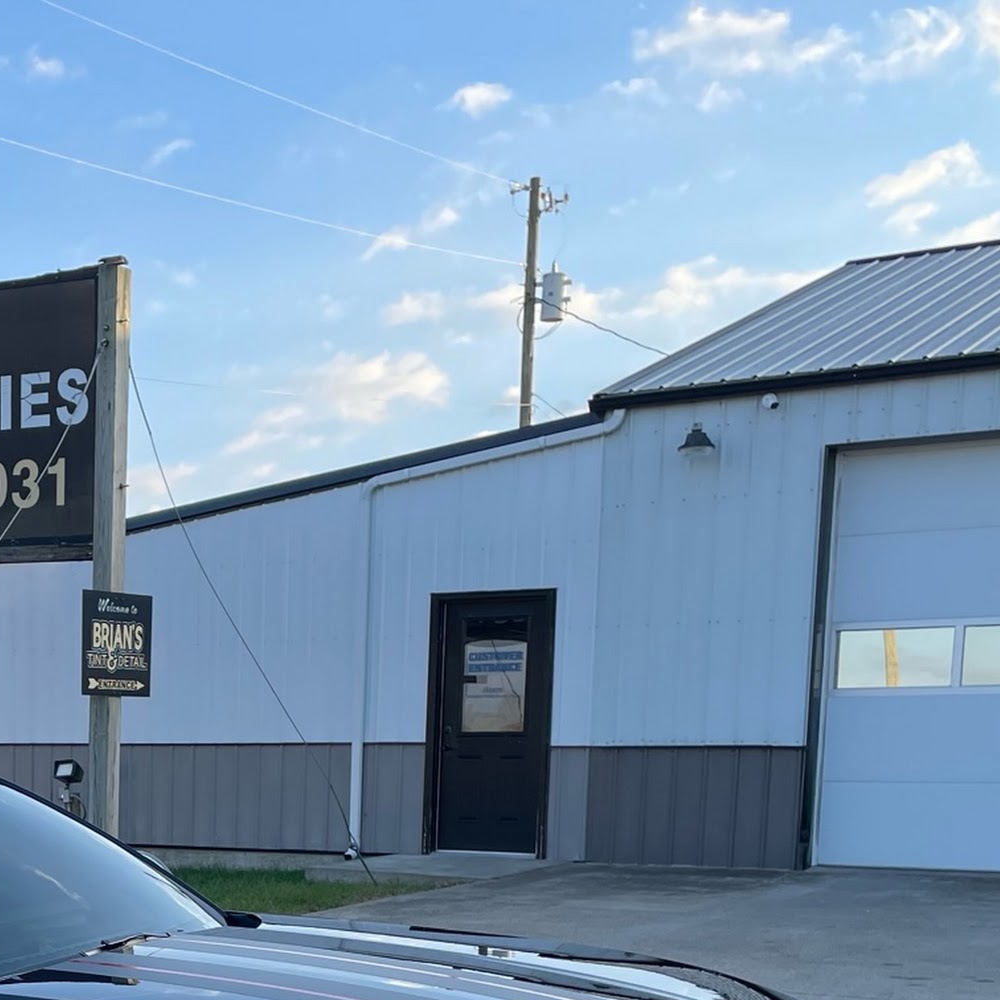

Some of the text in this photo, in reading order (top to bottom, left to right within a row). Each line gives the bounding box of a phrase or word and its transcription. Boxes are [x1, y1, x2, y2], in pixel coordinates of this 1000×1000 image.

[98, 598, 138, 615] Welcome to
[93, 622, 143, 650] BRIAN'S
[87, 648, 147, 671] TINT & DETAIL
[98, 679, 135, 690] ENTRANCE
